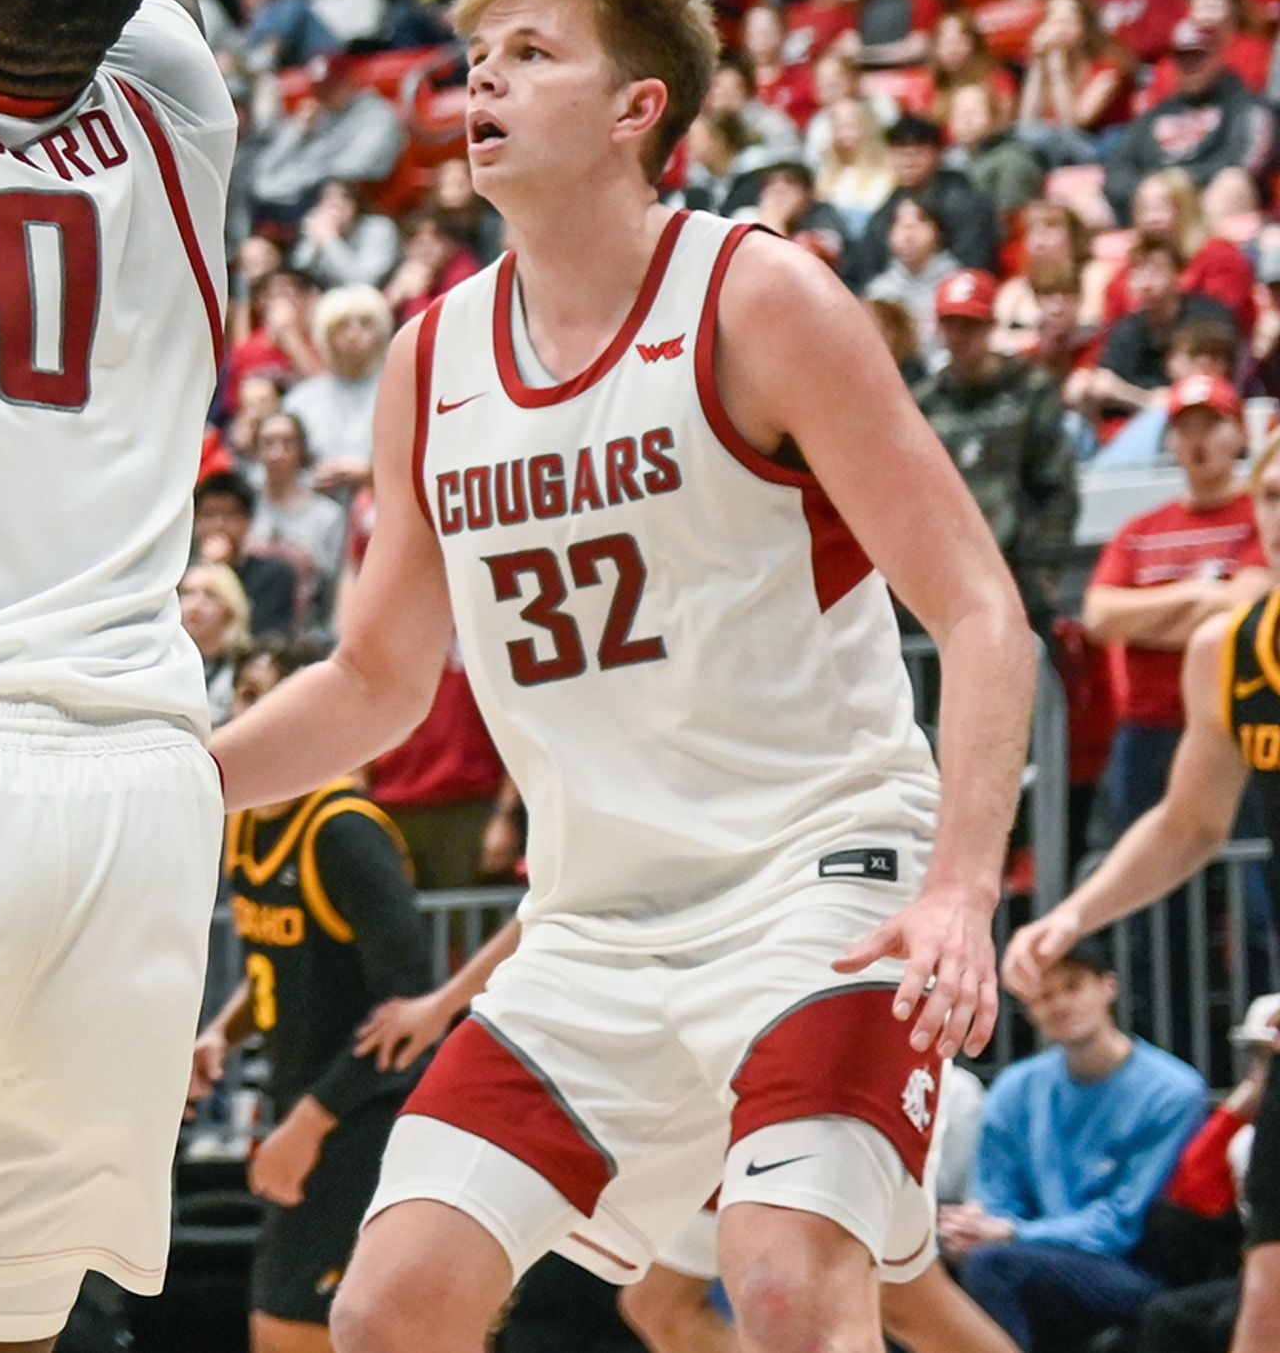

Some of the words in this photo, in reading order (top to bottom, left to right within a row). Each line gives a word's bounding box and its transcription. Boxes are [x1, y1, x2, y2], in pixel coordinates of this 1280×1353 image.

[436, 426, 683, 536] COUGARS
[479, 532, 668, 687] 32
[870, 856, 891, 871] XL
